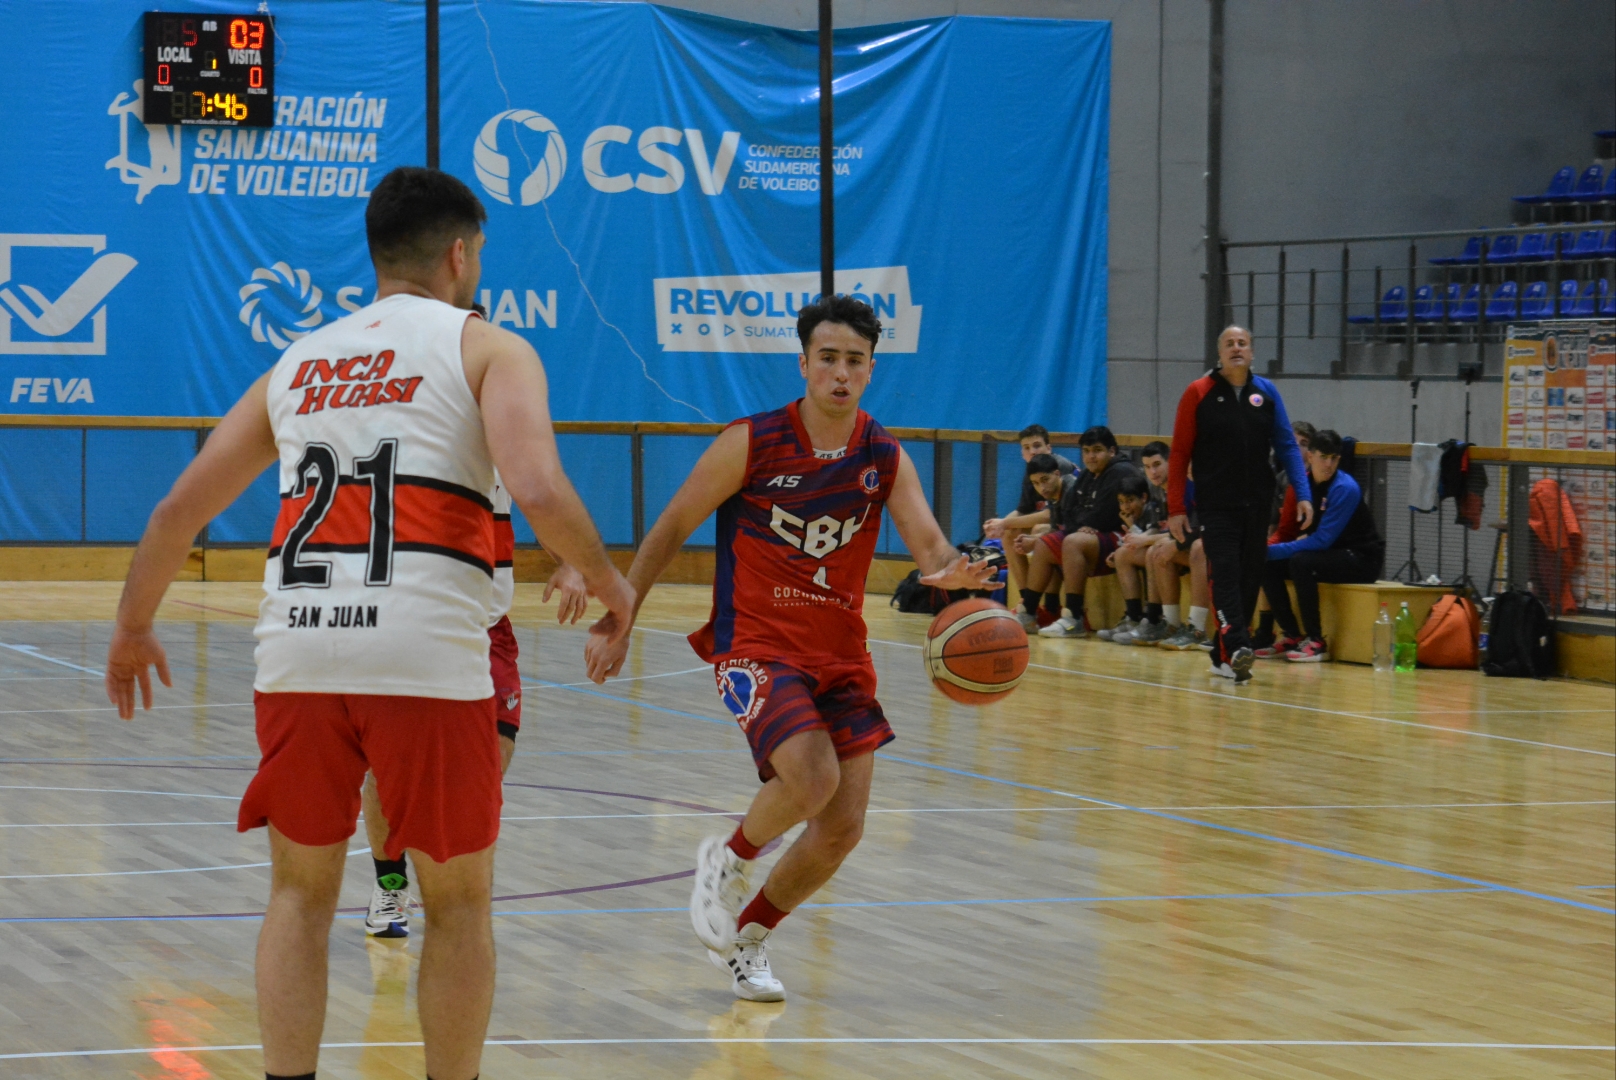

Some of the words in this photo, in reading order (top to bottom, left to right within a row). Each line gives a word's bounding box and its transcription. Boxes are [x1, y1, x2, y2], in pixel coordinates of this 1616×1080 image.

[230, 19, 265, 49] 03
[157, 47, 193, 62] LOCAL
[212, 58, 218, 70] 1
[227, 49, 262, 65] VISITA
[158, 64, 170, 85] 0
[249, 66, 262, 88] 0
[192, 91, 248, 120] 7:46
[274, 92, 387, 129] RACIÓN
[581, 125, 741, 196] CSV
[748, 144, 863, 160] CONFEDERCIÓN
[744, 160, 850, 176] SUDAMERICNA
[188, 164, 230, 195] DE
[236, 165, 372, 198] VOLEIBOL
[738, 176, 759, 190] DE
[760, 177, 820, 192] VOLEIBO
[289, 349, 395, 390] INCA
[9, 377, 95, 404] FEVA
[296, 376, 423, 415] HUASI
[278, 438, 398, 590] 21
[288, 606, 322, 628] SAN
[328, 606, 378, 628] JUAN
